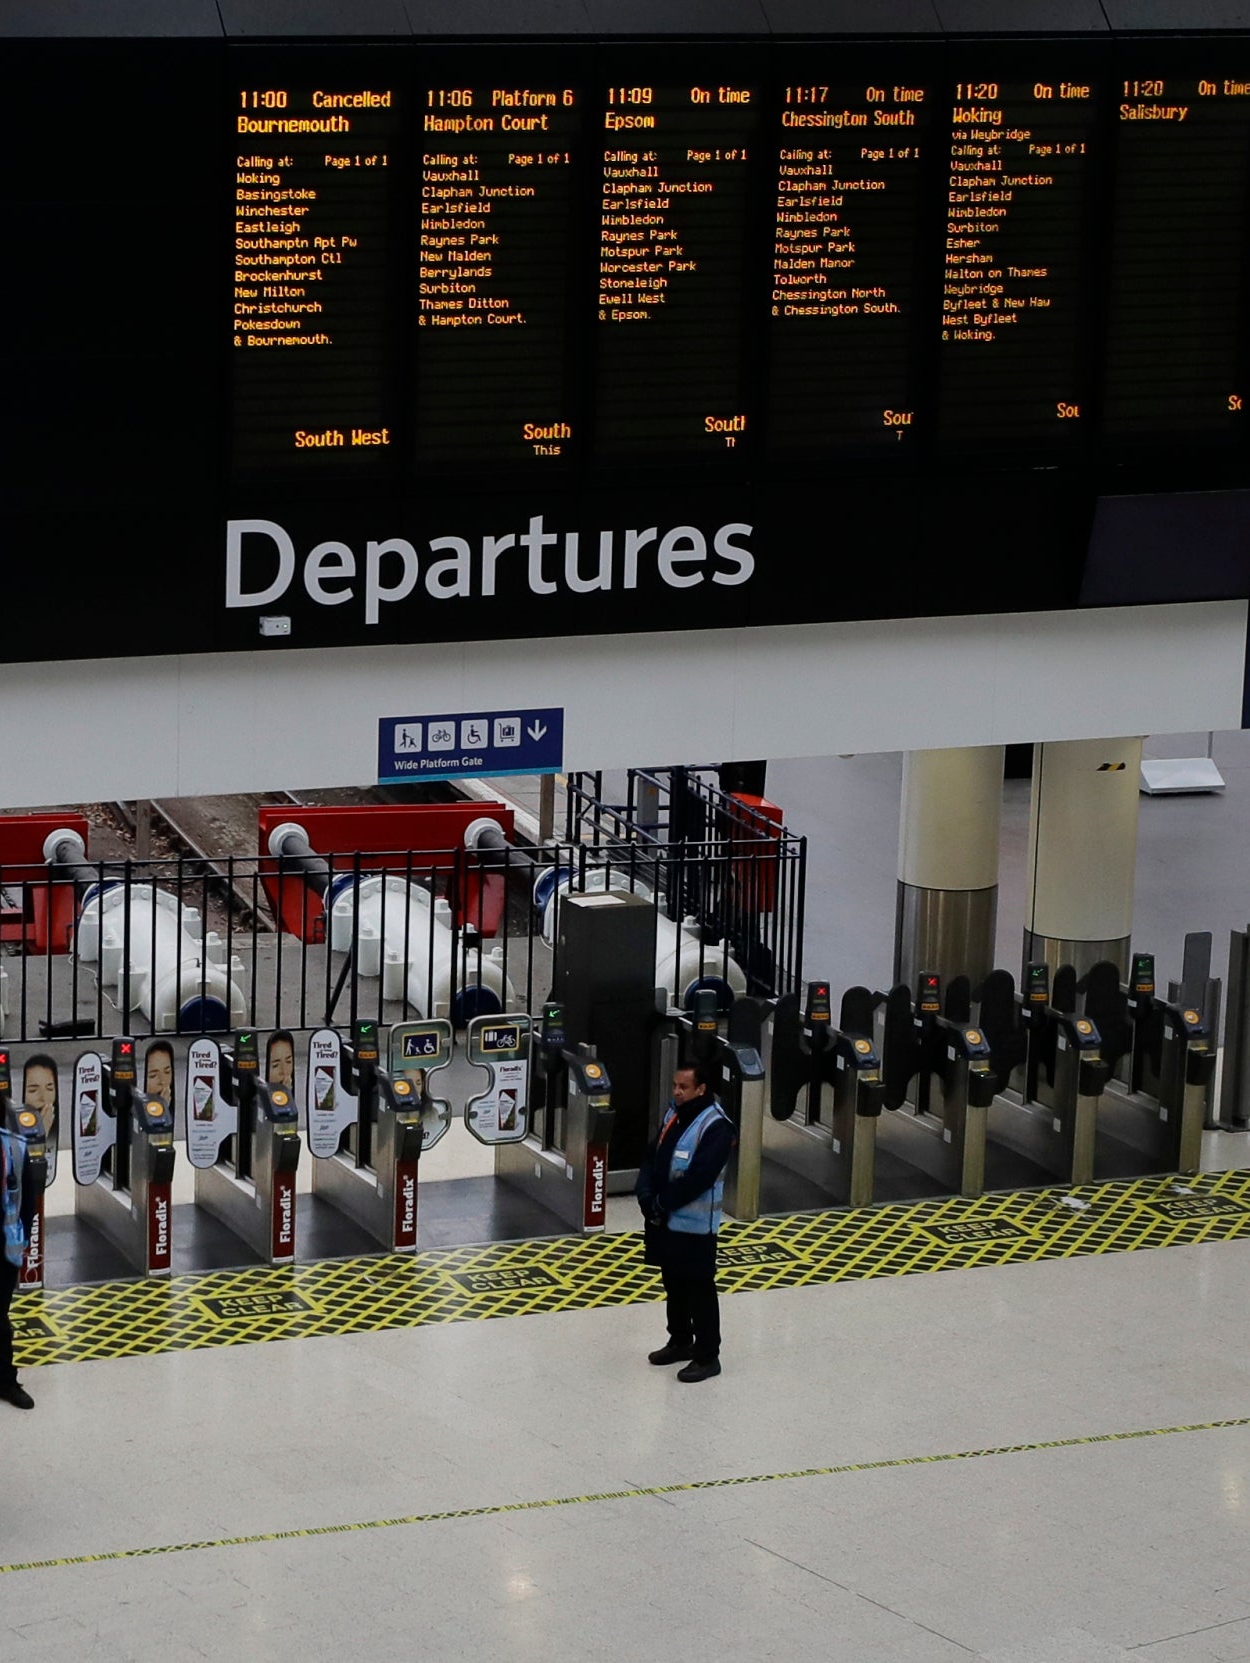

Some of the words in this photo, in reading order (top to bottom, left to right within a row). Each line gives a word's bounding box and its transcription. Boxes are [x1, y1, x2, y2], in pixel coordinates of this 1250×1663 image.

[957, 84, 998, 100] 11:20
[1034, 83, 1052, 98] On
[1060, 83, 1089, 98] time
[1124, 81, 1163, 96] 11:20
[1198, 80, 1216, 95] On
[1224, 80, 1250, 95] time
[241, 91, 287, 108] 11:00
[313, 91, 391, 108] Cancelled
[428, 90, 472, 106] 11:06
[492, 90, 556, 106] Platform
[563, 90, 573, 106] 6
[609, 88, 652, 104] 11:09
[691, 87, 710, 103] On
[718, 87, 750, 103] time
[786, 87, 828, 103] 11:17
[866, 87, 884, 102] On
[894, 87, 924, 102] time
[782, 111, 867, 128] Chessington
[874, 110, 914, 125] South
[953, 108, 1002, 125] Woking
[1120, 104, 1188, 121] Salisbury
[238, 116, 349, 133] Bournemouth
[424, 115, 494, 133] Hampton
[502, 114, 548, 130] Court
[605, 112, 654, 130] Epsom
[971, 129, 1030, 142] Weybridge
[237, 156, 273, 169] Calling
[278, 156, 293, 166] at:
[325, 156, 350, 169] Page
[355, 156, 360, 166] 1
[365, 155, 377, 166] of
[382, 155, 387, 166] 1
[237, 173, 280, 186] Woking
[236, 188, 316, 202] Basingstoke
[422, 187, 472, 199] Clapham
[479, 186, 534, 196] Junction
[236, 205, 309, 216] Winchester
[422, 202, 490, 214] Earlsfield
[236, 221, 300, 234] Eastleigh
[422, 219, 485, 229] Wimbledon
[236, 237, 308, 250] Southamptn
[314, 237, 336, 250] Apt
[342, 236, 357, 247] Pw
[421, 235, 465, 248] Raynes
[471, 234, 498, 244] Park
[947, 238, 980, 248] Esher
[420, 251, 442, 261] New
[448, 251, 491, 261] Malden
[601, 246, 650, 259] Motspur
[655, 245, 682, 255] Park
[946, 253, 992, 263] Hersham
[236, 254, 316, 266] Southampton
[322, 253, 341, 264] Ctl
[774, 259, 815, 269] Malden
[820, 258, 854, 268] Manor
[420, 266, 492, 280] Berrylands
[600, 262, 663, 272] Worcester
[669, 261, 696, 271] Park
[945, 269, 983, 278] Walton
[988, 270, 1002, 278] on
[1008, 267, 1047, 277] Thames
[235, 270, 322, 282] Brockenhurst
[774, 274, 826, 284] Tolworth
[420, 283, 476, 294] Surbiton
[600, 277, 667, 290] Stoneleigh
[944, 284, 1003, 296] Weybridge
[235, 287, 258, 298] New
[264, 286, 305, 297] Milton
[599, 294, 632, 304] Ewell
[638, 293, 665, 303] West
[772, 289, 846, 301] Chessington
[852, 288, 885, 298] North
[234, 302, 322, 314] Christchurch
[419, 299, 463, 309] Thames
[469, 298, 508, 308] Ditton
[772, 306, 779, 316] &
[784, 304, 858, 316] Chessington
[864, 303, 900, 313] South.
[944, 299, 986, 312] Byfleet
[992, 298, 999, 308] &
[1004, 298, 1024, 308] New
[1030, 297, 1050, 306] Haw
[234, 319, 300, 330] Pokesdown
[419, 315, 426, 325] &
[432, 314, 482, 327] Hampton
[488, 313, 526, 324] Court.
[942, 315, 968, 325] West
[974, 314, 1017, 326] Byfleet
[234, 336, 242, 346] &
[248, 334, 332, 346] Bournemouth.
[942, 331, 948, 340] &
[954, 330, 995, 341] Woking.
[295, 430, 344, 447] South
[352, 428, 390, 445] West
[524, 423, 570, 440] South
[533, 445, 560, 455] This
[226, 515, 755, 624] Departures
[394, 760, 418, 770] Wide
[420, 756, 459, 769] Platform
[461, 756, 483, 768] Gate
[313, 1041, 332, 1049] Tired
[191, 1051, 210, 1059] Tired
[316, 1051, 338, 1060] Tired?
[195, 1060, 217, 1069] Tired?
[1161, 1197, 1222, 1212] KEEP
[1168, 1203, 1242, 1219] CLEAR
[937, 1220, 998, 1235] KEEP
[943, 1227, 1021, 1242] CLEAR
[468, 1268, 532, 1283] KEEP
[471, 1275, 549, 1291] CLEAR
[219, 1293, 285, 1309] KEEP
[221, 1300, 302, 1317] CLEAR
[9, 1559, 59, 1571] BEHIND
[63, 1555, 87, 1565] THE
[91, 1552, 119, 1561] LINE
